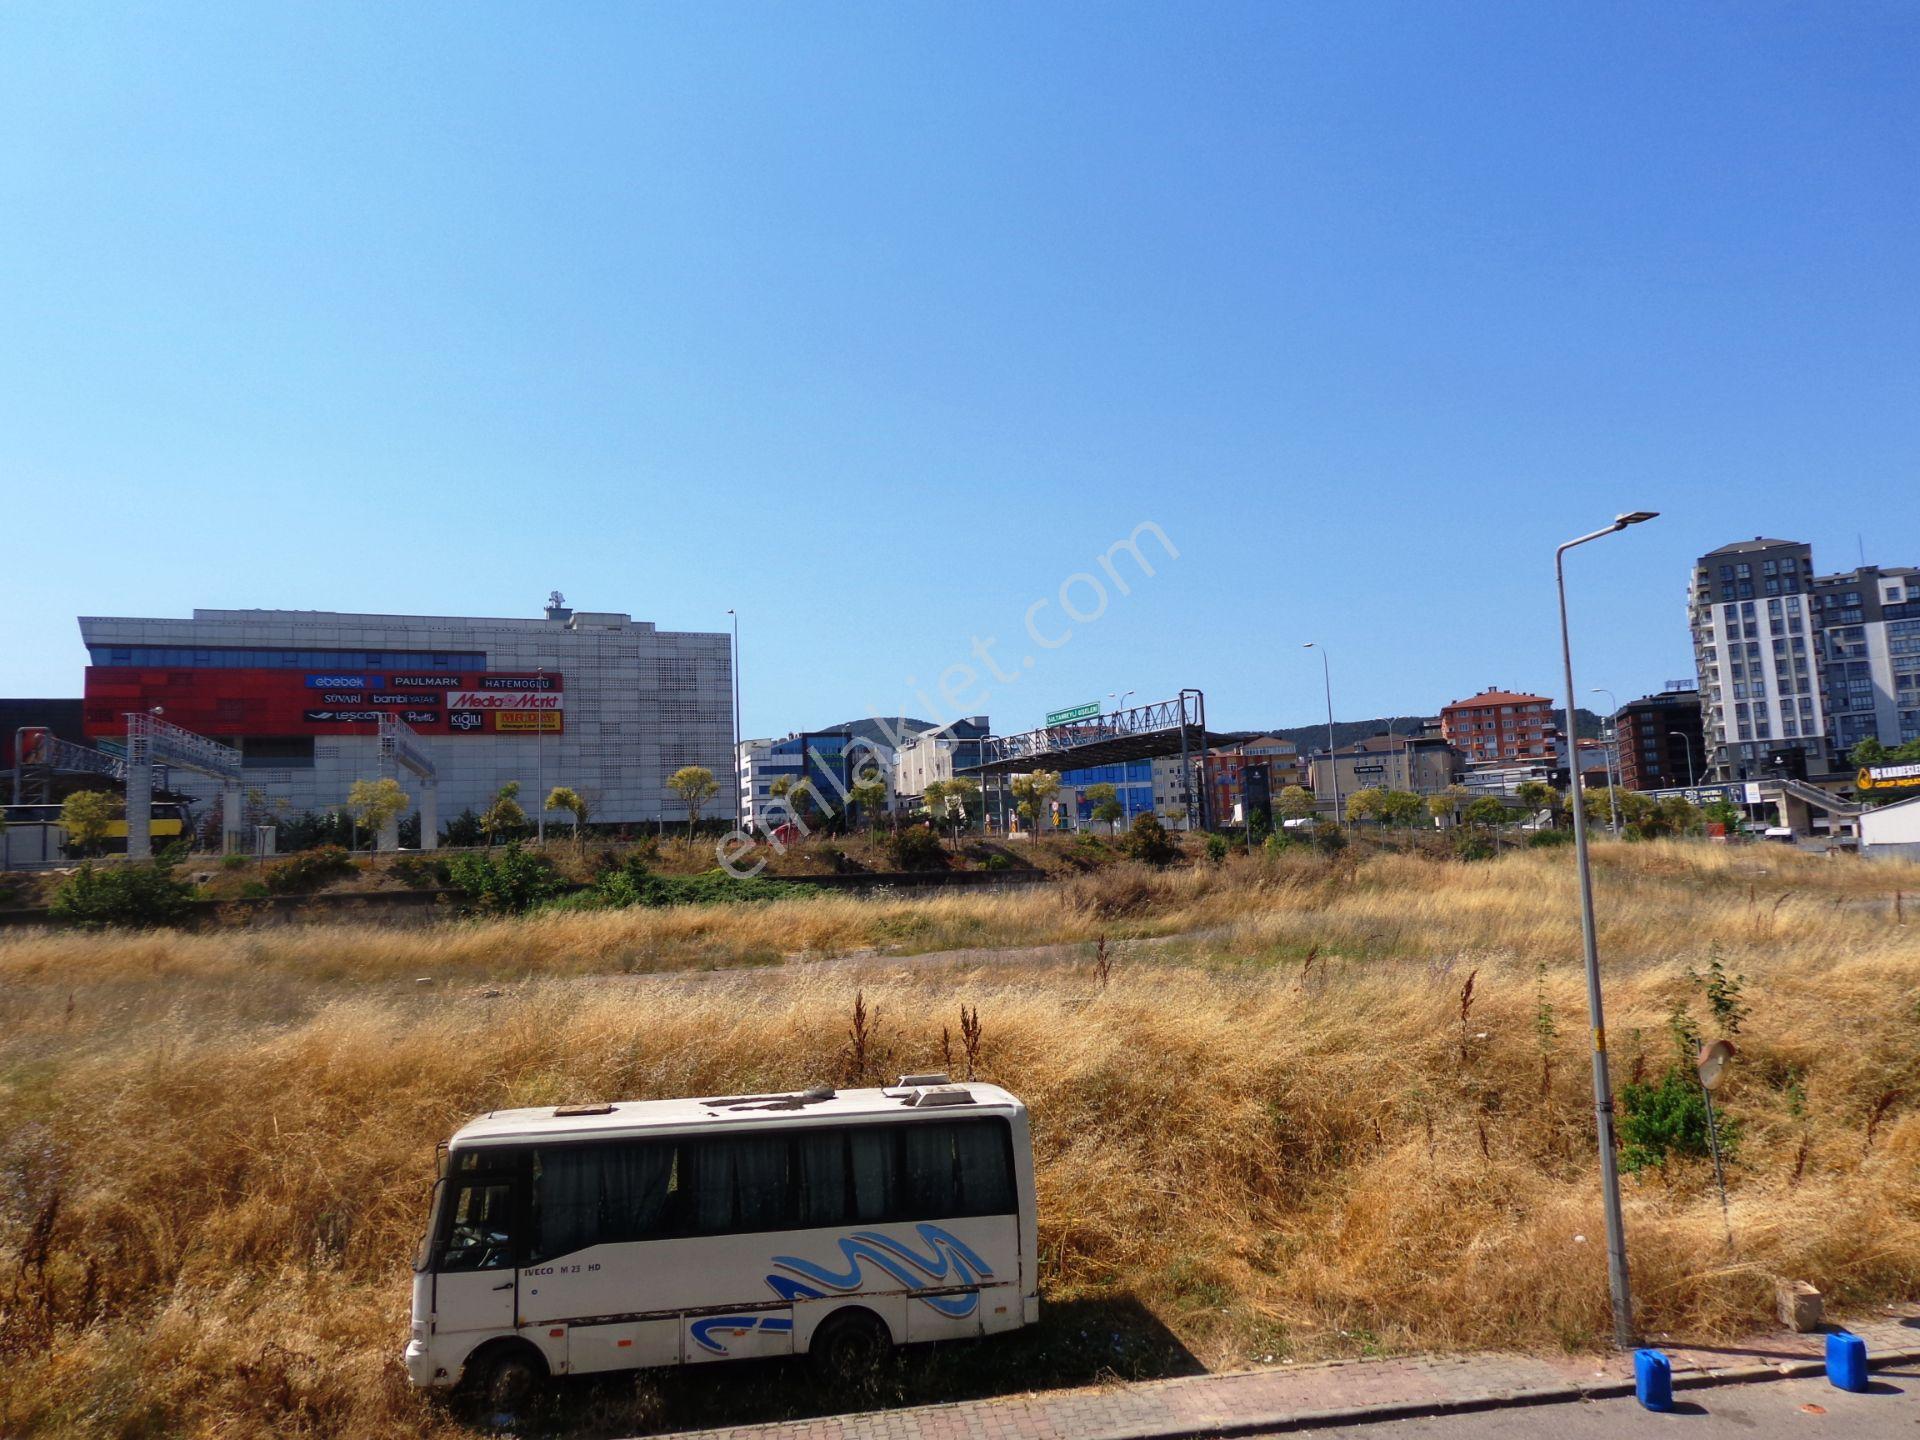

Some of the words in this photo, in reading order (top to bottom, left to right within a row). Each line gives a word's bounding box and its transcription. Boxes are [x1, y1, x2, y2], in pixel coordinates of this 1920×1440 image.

[315, 676, 364, 687] ebebek
[395, 677, 459, 686] PAULMARK
[373, 694, 407, 703] bambi
[452, 693, 503, 708] Media
[514, 693, 558, 708] Markt
[524, 1267, 554, 1276] IVECO
[571, 1265, 581, 1273] 23
[588, 1263, 601, 1271] HD
